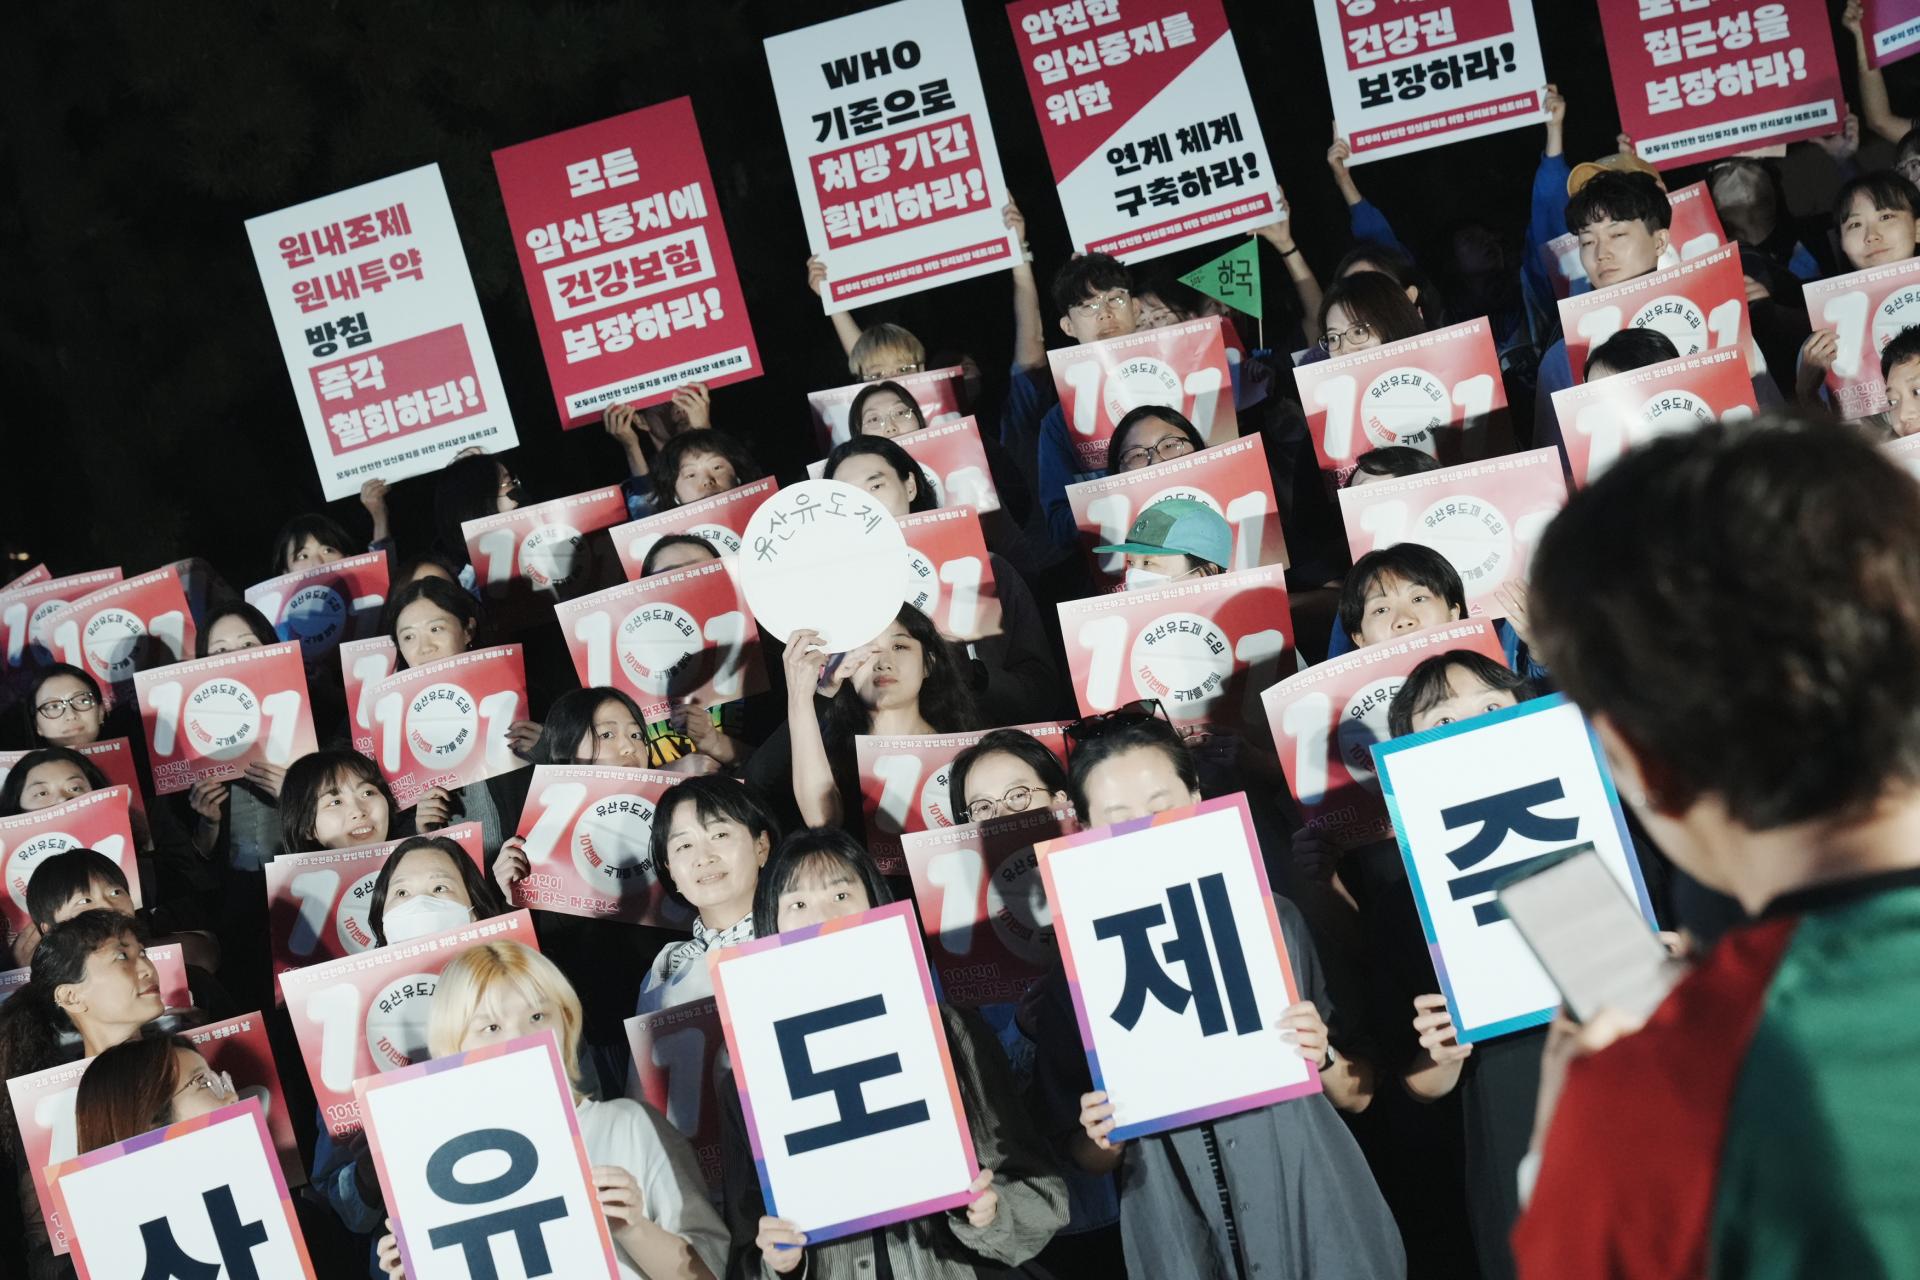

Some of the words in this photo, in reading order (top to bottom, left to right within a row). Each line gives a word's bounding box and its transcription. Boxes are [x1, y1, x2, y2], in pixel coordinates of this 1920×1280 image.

[1021, 0, 1121, 45] 안전한
[1347, 6, 1457, 64] 건강권
[1643, 3, 1790, 67] 접근성을
[821, 40, 921, 89] WHO
[1033, 12, 1196, 86] 임신중지를
[1358, 42, 1516, 109] 보장하라!
[1645, 47, 1807, 115] 보장하라!
[811, 79, 955, 143] 기준으로
[1045, 80, 1113, 126] 위한
[1106, 132, 1173, 176] 연계
[1175, 113, 1244, 157] 체계
[1643, 140, 1670, 155] 모두의
[1670, 135, 1696, 149] 안전한
[1697, 126, 1738, 143] 임신중지를
[1740, 122, 1758, 134] 위한
[1759, 114, 1793, 130] 권리보장
[1794, 107, 1828, 122] 네트워크
[567, 148, 639, 197] 모든
[818, 142, 891, 193] 처방
[898, 124, 971, 173] 기간
[822, 168, 985, 239] 확대하라!
[1113, 152, 1260, 218] 구축하라!
[278, 202, 413, 269] 원내조제
[526, 182, 708, 263] 임신중지에
[291, 247, 425, 313] 원내투약
[557, 238, 703, 309] 건강보험
[1217, 260, 1253, 296] 한국
[305, 312, 373, 357] 방침
[562, 289, 725, 364] 보장하라!
[1636, 302, 1684, 328] 유산유도제
[1683, 309, 1701, 329] 도입
[317, 355, 386, 402] 즉각
[572, 395, 597, 409] 모두의
[597, 388, 621, 402] 안전한
[621, 377, 661, 395] 임신중지를
[661, 373, 677, 384] 위한
[678, 364, 709, 379] 권리보장
[710, 355, 742, 371] 네트워크
[1371, 373, 1423, 398] 유산유도제
[1422, 382, 1443, 402] 도입
[328, 376, 480, 448] 철회하라!
[1370, 415, 1398, 443] 101번째
[335, 466, 359, 480] 모두의
[359, 459, 382, 473] 안전한
[382, 448, 419, 467] 임신중지를
[419, 443, 436, 455] 위한
[436, 434, 467, 450] 권리보장
[467, 425, 497, 441] 네트워크
[753, 492, 883, 563] 유산유도제
[1424, 503, 1482, 528] 유산유도제
[1480, 513, 1504, 536] 도입
[722, 535, 741, 553] 도입
[910, 558, 930, 579] 도입
[625, 609, 674, 634] 유산유도제
[674, 617, 695, 637] 도입
[1144, 620, 1203, 646] 유산유도제
[1203, 631, 1225, 655] 도입
[624, 651, 651, 678] 101번째
[1138, 664, 1171, 698] 101번째
[1174, 686, 1204, 702] 국가를
[1202, 671, 1222, 692] 향해
[193, 684, 238, 705] 유산유도제
[237, 692, 254, 711] 도입
[413, 689, 456, 713] 유산유도제
[454, 696, 472, 714] 도입
[435, 741, 457, 756] 국가를
[455, 727, 469, 745] 향해
[596, 801, 653, 822] 유산유도제
[18, 838, 68, 861] 유산유도제
[579, 833, 603, 868] 101번째
[541, 890, 569, 906] 하는
[343, 916, 372, 948] 101번째
[437, 933, 458, 948] 위한
[457, 928, 478, 943] 국제
[507, 917, 519, 930] 날
[1092, 872, 1263, 1037] 제
[210, 1023, 240, 1041] 행동의
[239, 1020, 251, 1033] 날
[773, 993, 931, 1156] 도
[426, 1128, 569, 1280] 유
